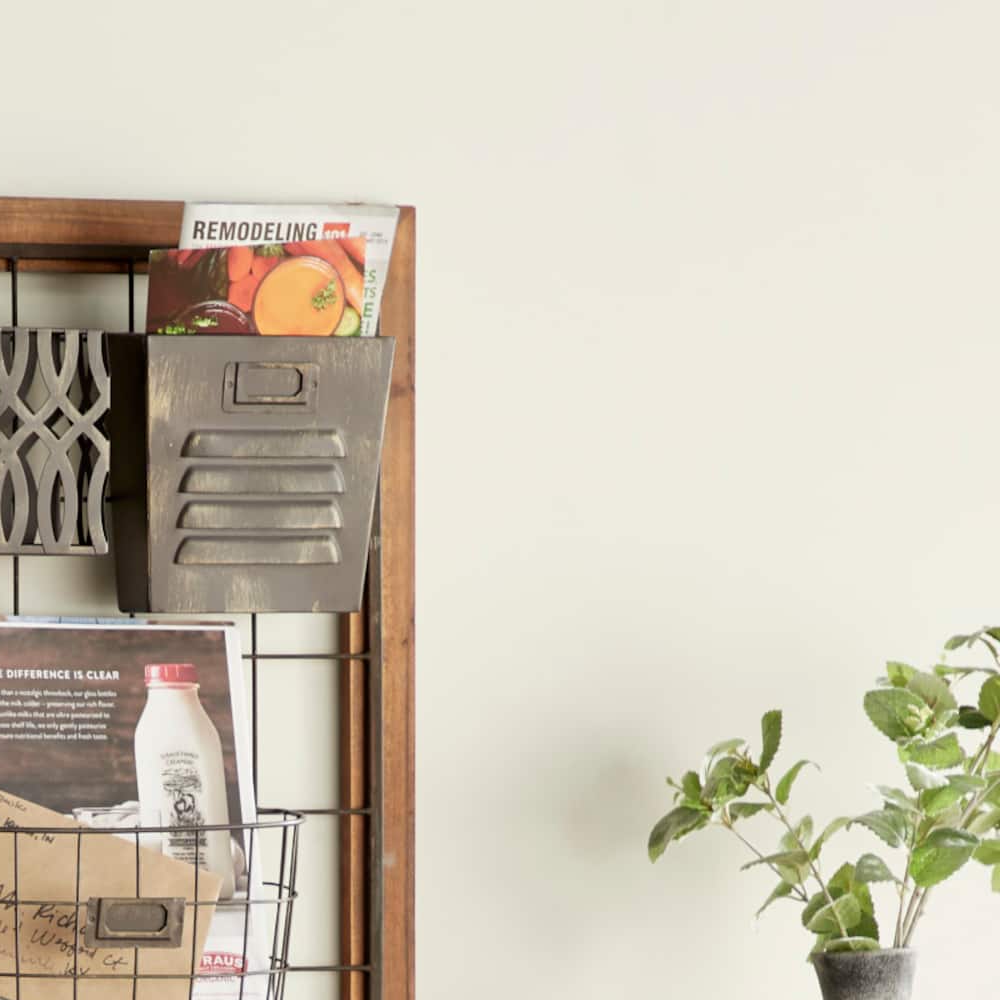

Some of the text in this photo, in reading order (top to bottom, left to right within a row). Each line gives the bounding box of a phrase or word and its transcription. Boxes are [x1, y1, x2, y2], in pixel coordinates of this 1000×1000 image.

[193, 220, 318, 242] REMODELING
[6, 668, 70, 680] DIFFERENCE
[73, 670, 83, 680] IS
[86, 670, 119, 680] CLEAR
